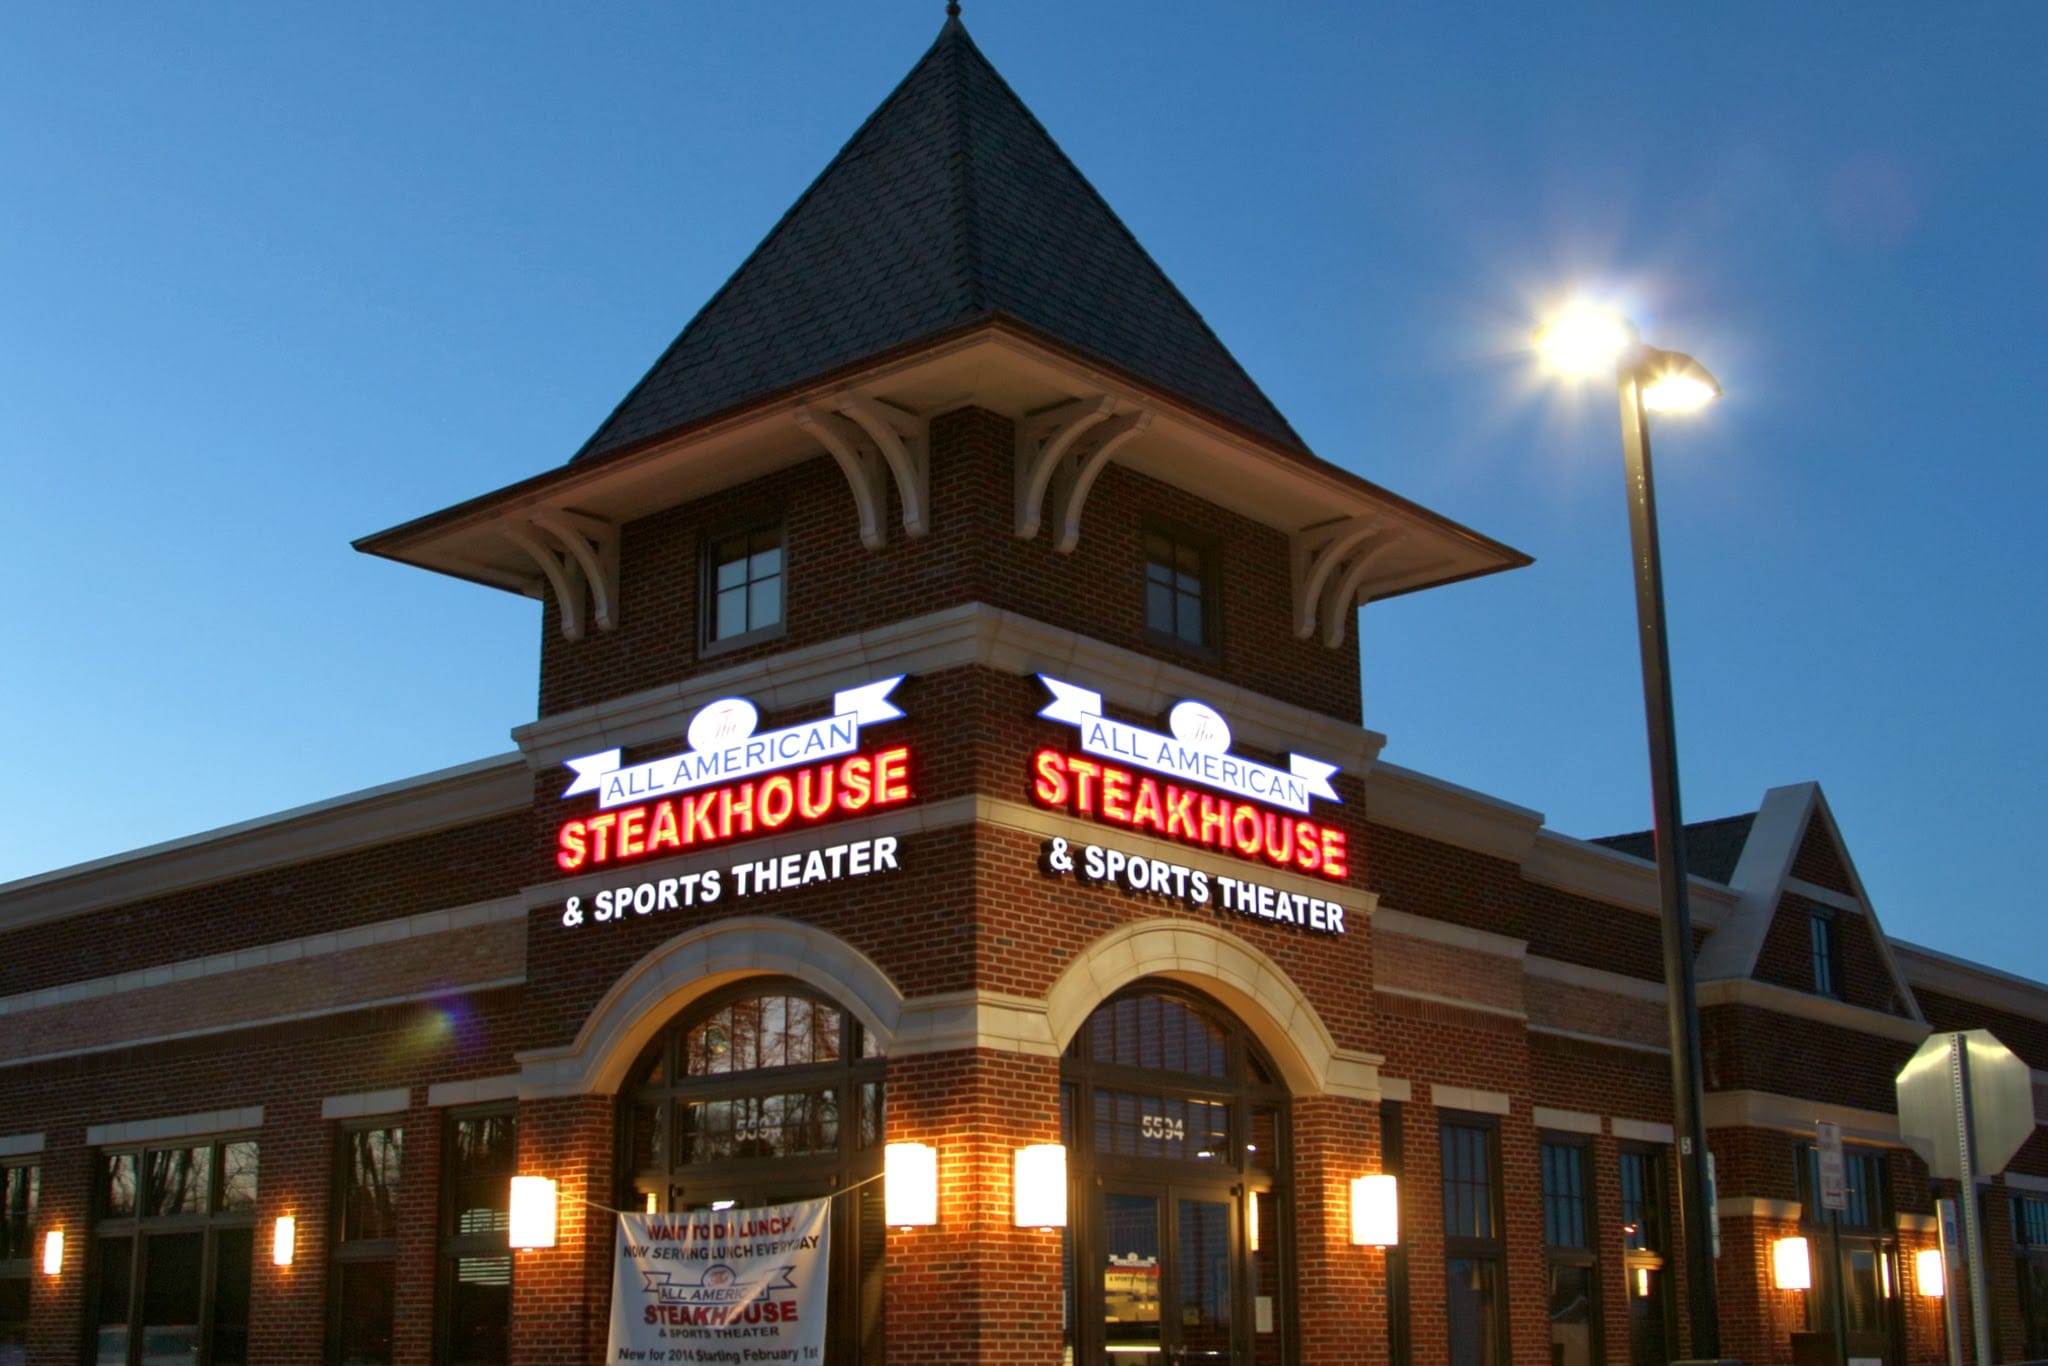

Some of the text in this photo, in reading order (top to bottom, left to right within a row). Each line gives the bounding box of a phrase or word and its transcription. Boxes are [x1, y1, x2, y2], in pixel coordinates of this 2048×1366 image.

[606, 720, 853, 801] ALL AMERICAN
[1088, 722, 1305, 805] ALL AMERICAN
[558, 748, 908, 869] STEAKHOUSE
[1036, 750, 1347, 877] STEAKHOUSE
[562, 836, 898, 927] & SPORTS THEATER
[1050, 837, 1345, 933] & SPORTS THEATER
[623, 1245, 650, 1259] NOW
[652, 1246, 709, 1261] SERVING
[712, 1245, 753, 1259] LUNCH
[647, 1223, 689, 1240] WANT
[693, 1223, 710, 1240] TO
[713, 1222, 735, 1239] DO
[643, 1301, 798, 1326] STEAKHOUSE
[661, 1286, 765, 1300] ALL AMERICN
[618, 1348, 645, 1360] New
[649, 1348, 666, 1360] for
[669, 1348, 694, 1361] 2014
[695, 1348, 742, 1363] Starting
[744, 1347, 799, 1362] February
[670, 1328, 711, 1338] SPORTS
[715, 1327, 780, 1337] THEATER
